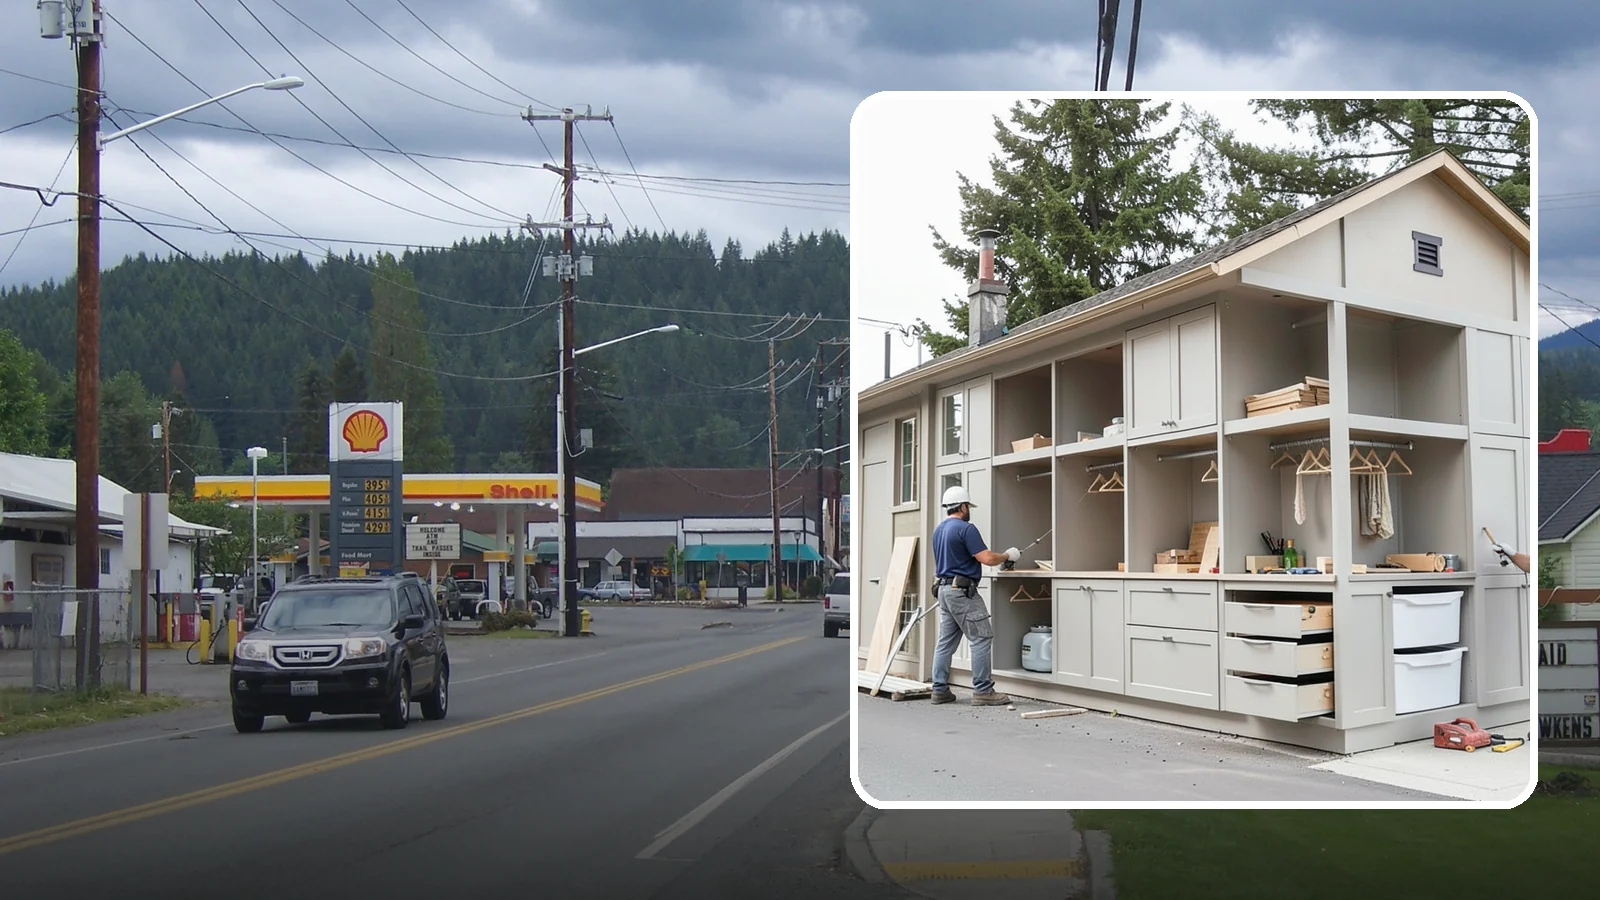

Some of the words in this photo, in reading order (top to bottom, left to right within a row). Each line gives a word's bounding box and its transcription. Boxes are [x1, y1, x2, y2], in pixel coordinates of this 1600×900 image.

[365, 480, 384, 490] 395
[489, 484, 547, 498] Shell
[365, 494, 384, 504] 405
[365, 508, 384, 518] 415
[365, 522, 384, 532] 429
